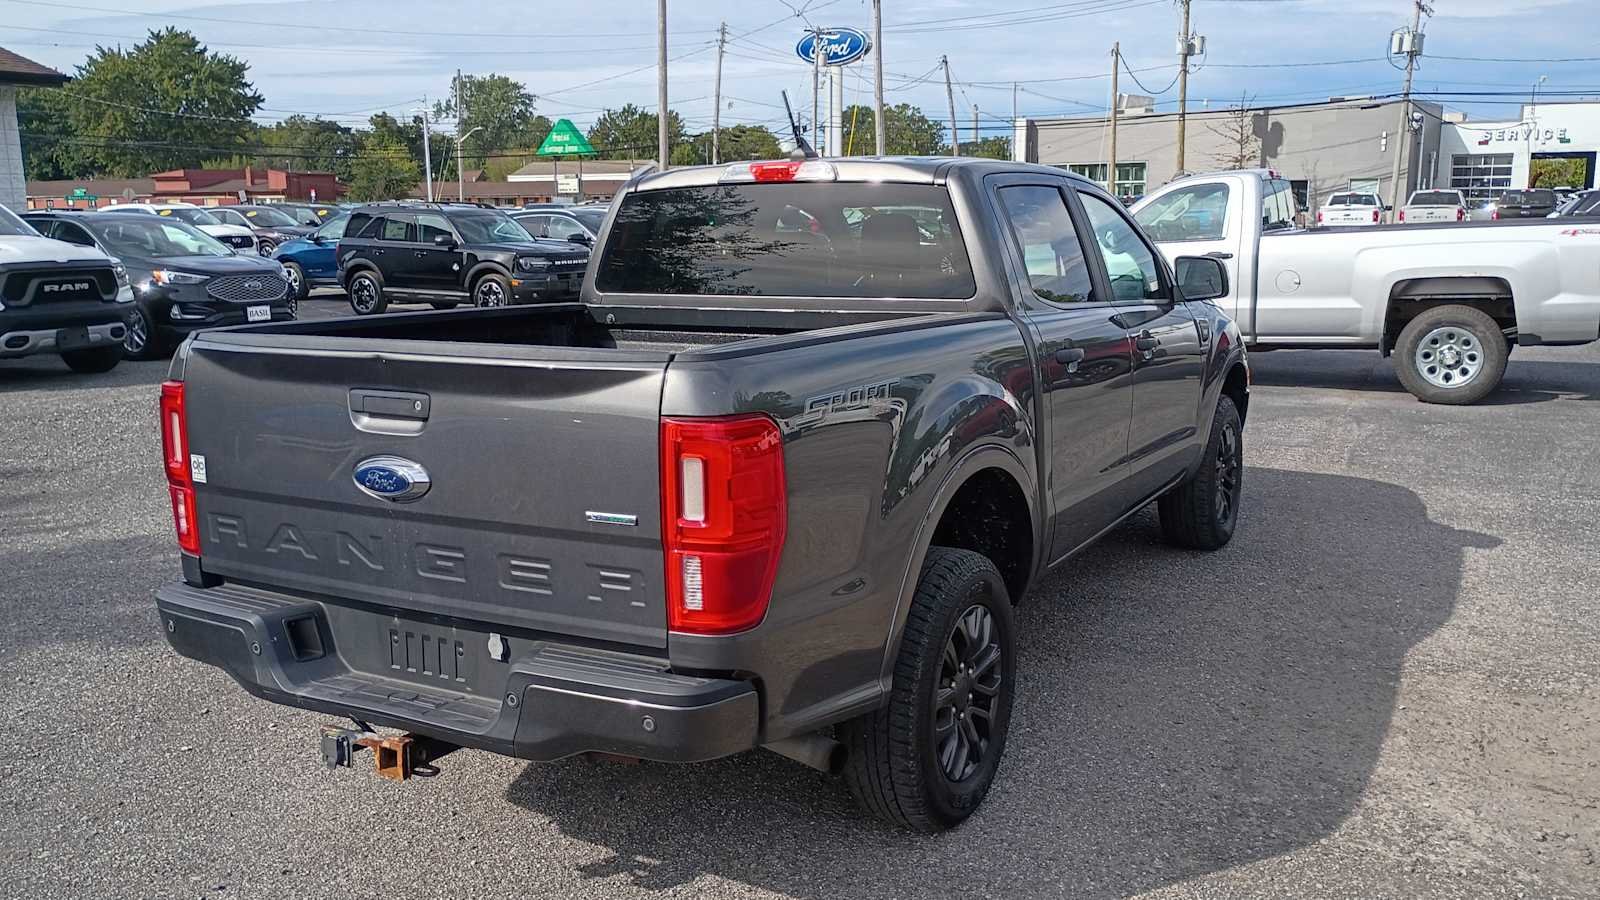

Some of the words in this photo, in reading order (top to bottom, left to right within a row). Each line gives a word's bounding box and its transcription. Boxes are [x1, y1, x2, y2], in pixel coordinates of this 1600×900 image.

[810, 34, 851, 57] Ford
[1483, 128, 1567, 142] SERVICE
[44, 283, 89, 292] RAM
[797, 378, 900, 427] SPORT
[365, 469, 397, 491] Ford
[207, 511, 647, 607] RANGER
